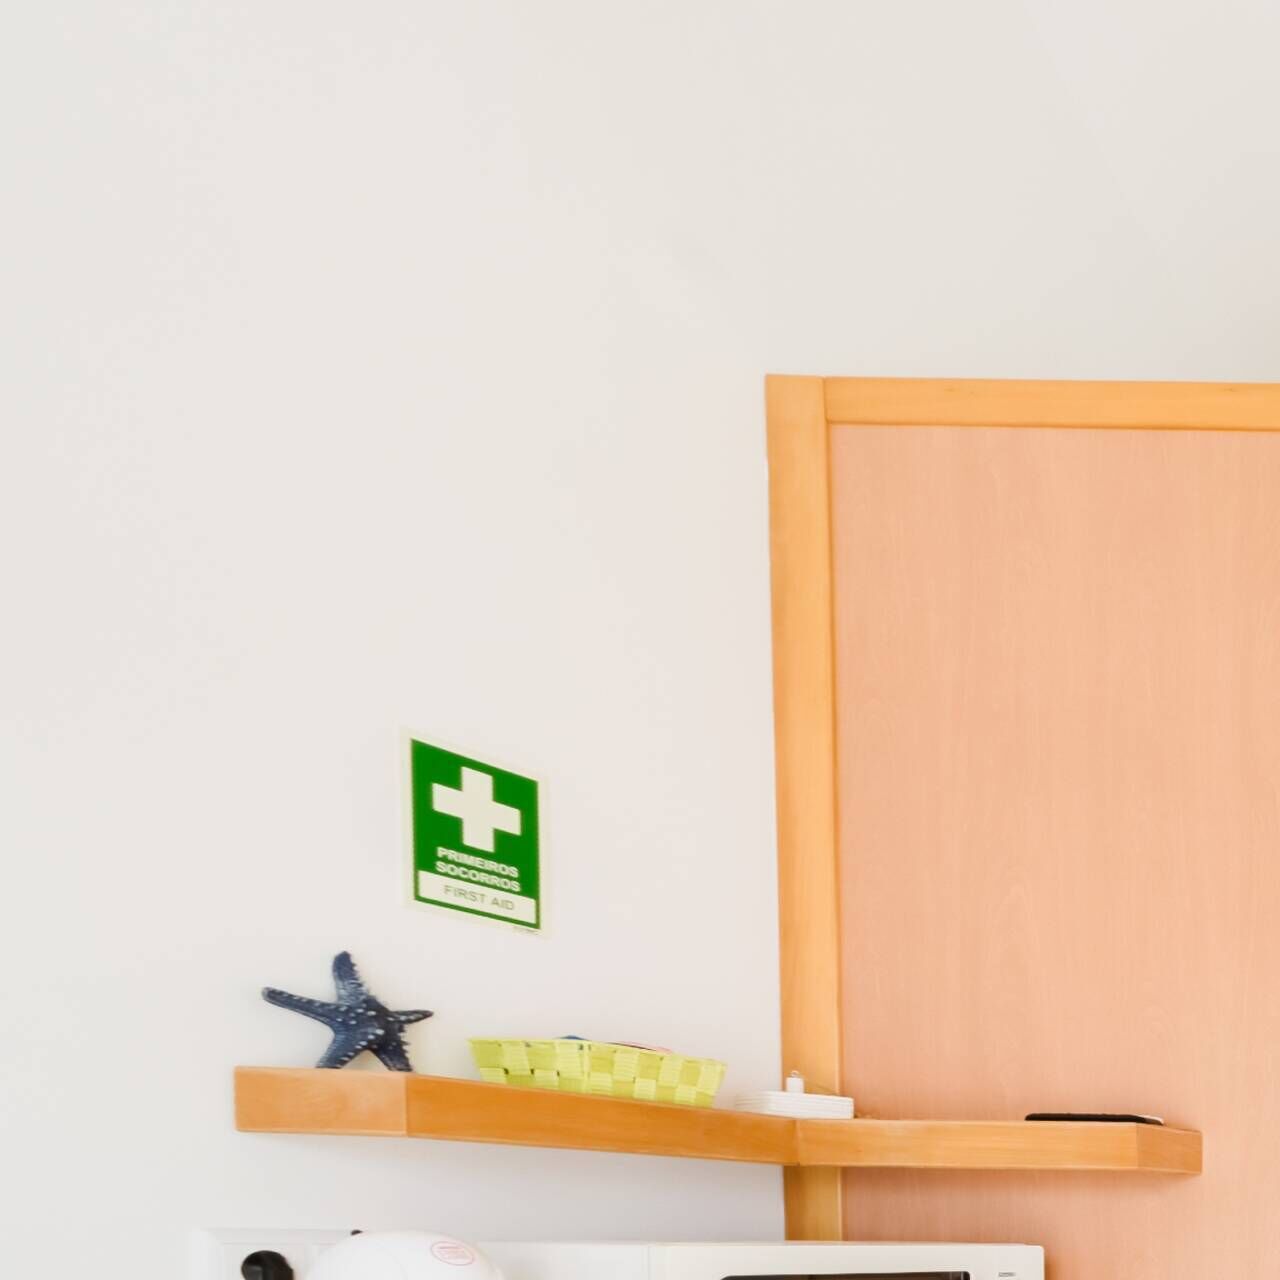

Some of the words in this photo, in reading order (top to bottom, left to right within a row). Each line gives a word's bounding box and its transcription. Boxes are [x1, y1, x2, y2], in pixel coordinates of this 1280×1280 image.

[435, 861, 521, 892] SOCORROS
[437, 846, 519, 878] PRIMEIROS
[444, 885, 487, 903] FIRST
[491, 897, 515, 911] AID
